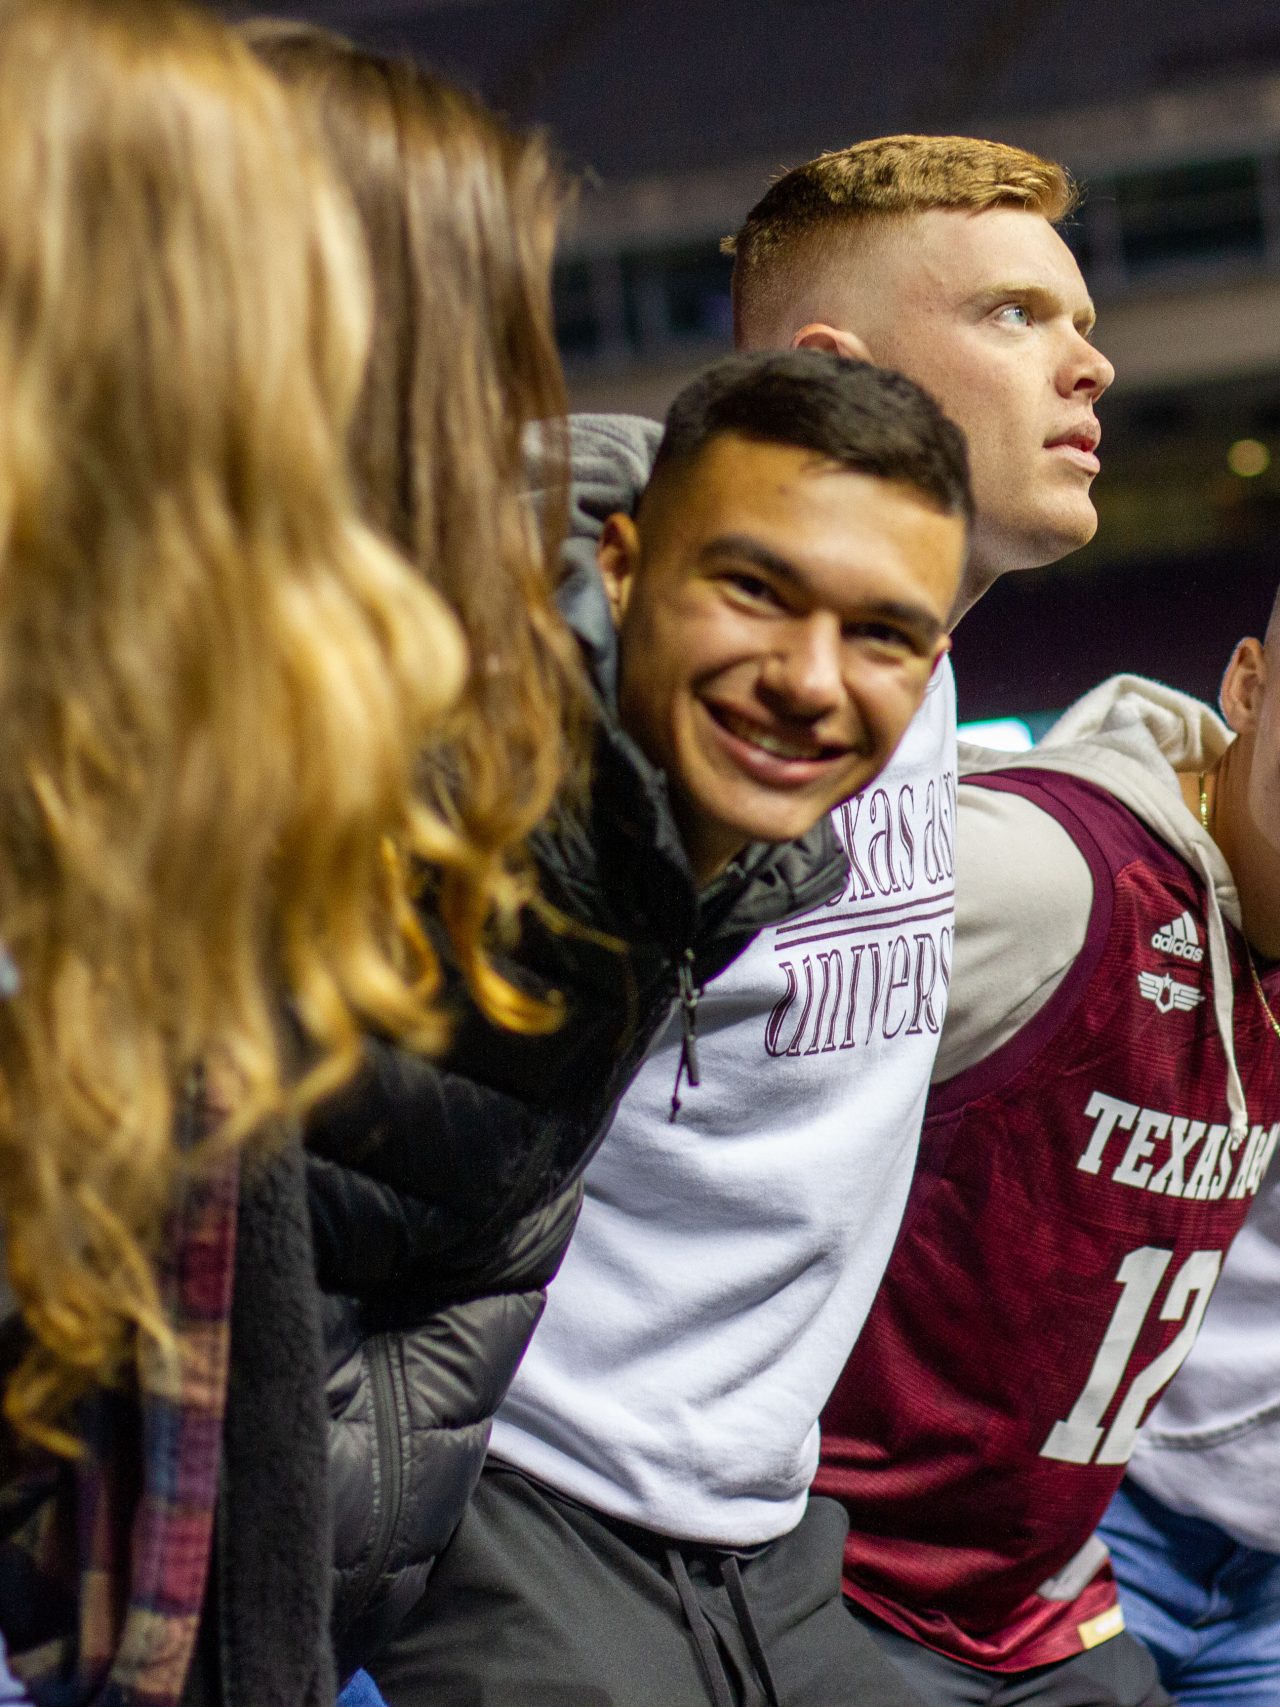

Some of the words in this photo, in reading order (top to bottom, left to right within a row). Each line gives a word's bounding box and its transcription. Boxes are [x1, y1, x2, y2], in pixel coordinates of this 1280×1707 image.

[1151, 932, 1204, 962] adidas
[1076, 1090, 1232, 1200] TEXAS
[1039, 1246, 1222, 1464] 12
